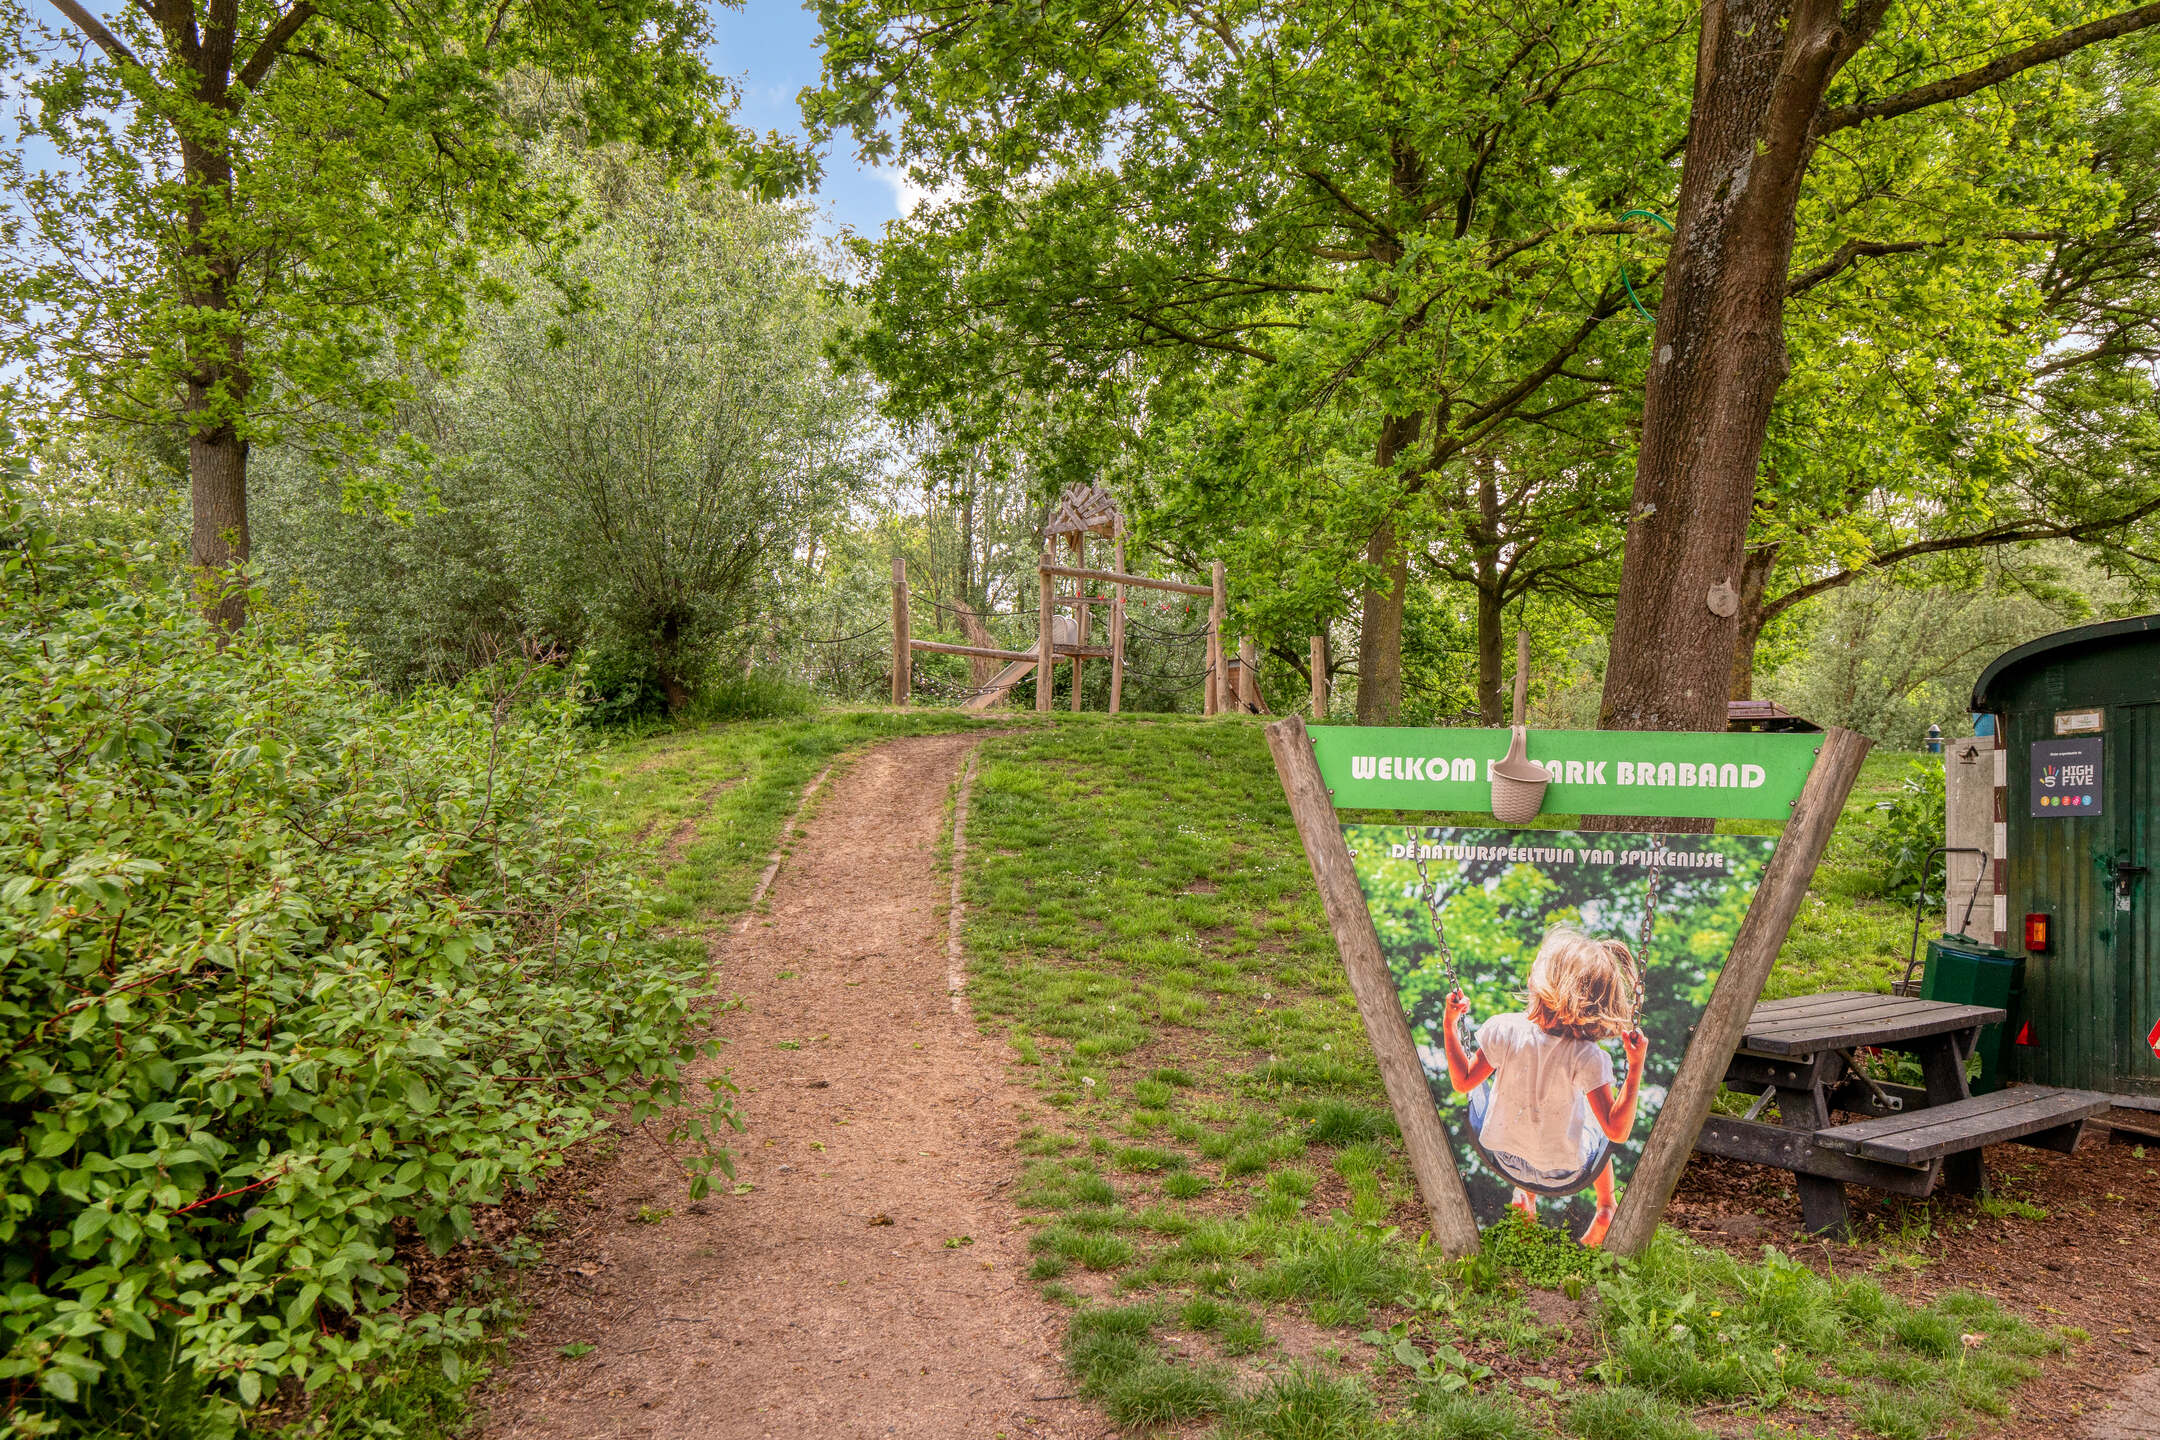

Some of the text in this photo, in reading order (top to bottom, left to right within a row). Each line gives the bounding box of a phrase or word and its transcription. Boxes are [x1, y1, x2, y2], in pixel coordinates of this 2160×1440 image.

[1351, 755, 1476, 782] WELKOM
[1528, 759, 1608, 785] ARK
[1616, 760, 1766, 789] BRABAND
[2062, 764, 2094, 776] HIGH
[2062, 775, 2094, 786] FIVE
[1391, 843, 1724, 868] DE NATUURSPEELTUIN VAN SPIJKENISSE
